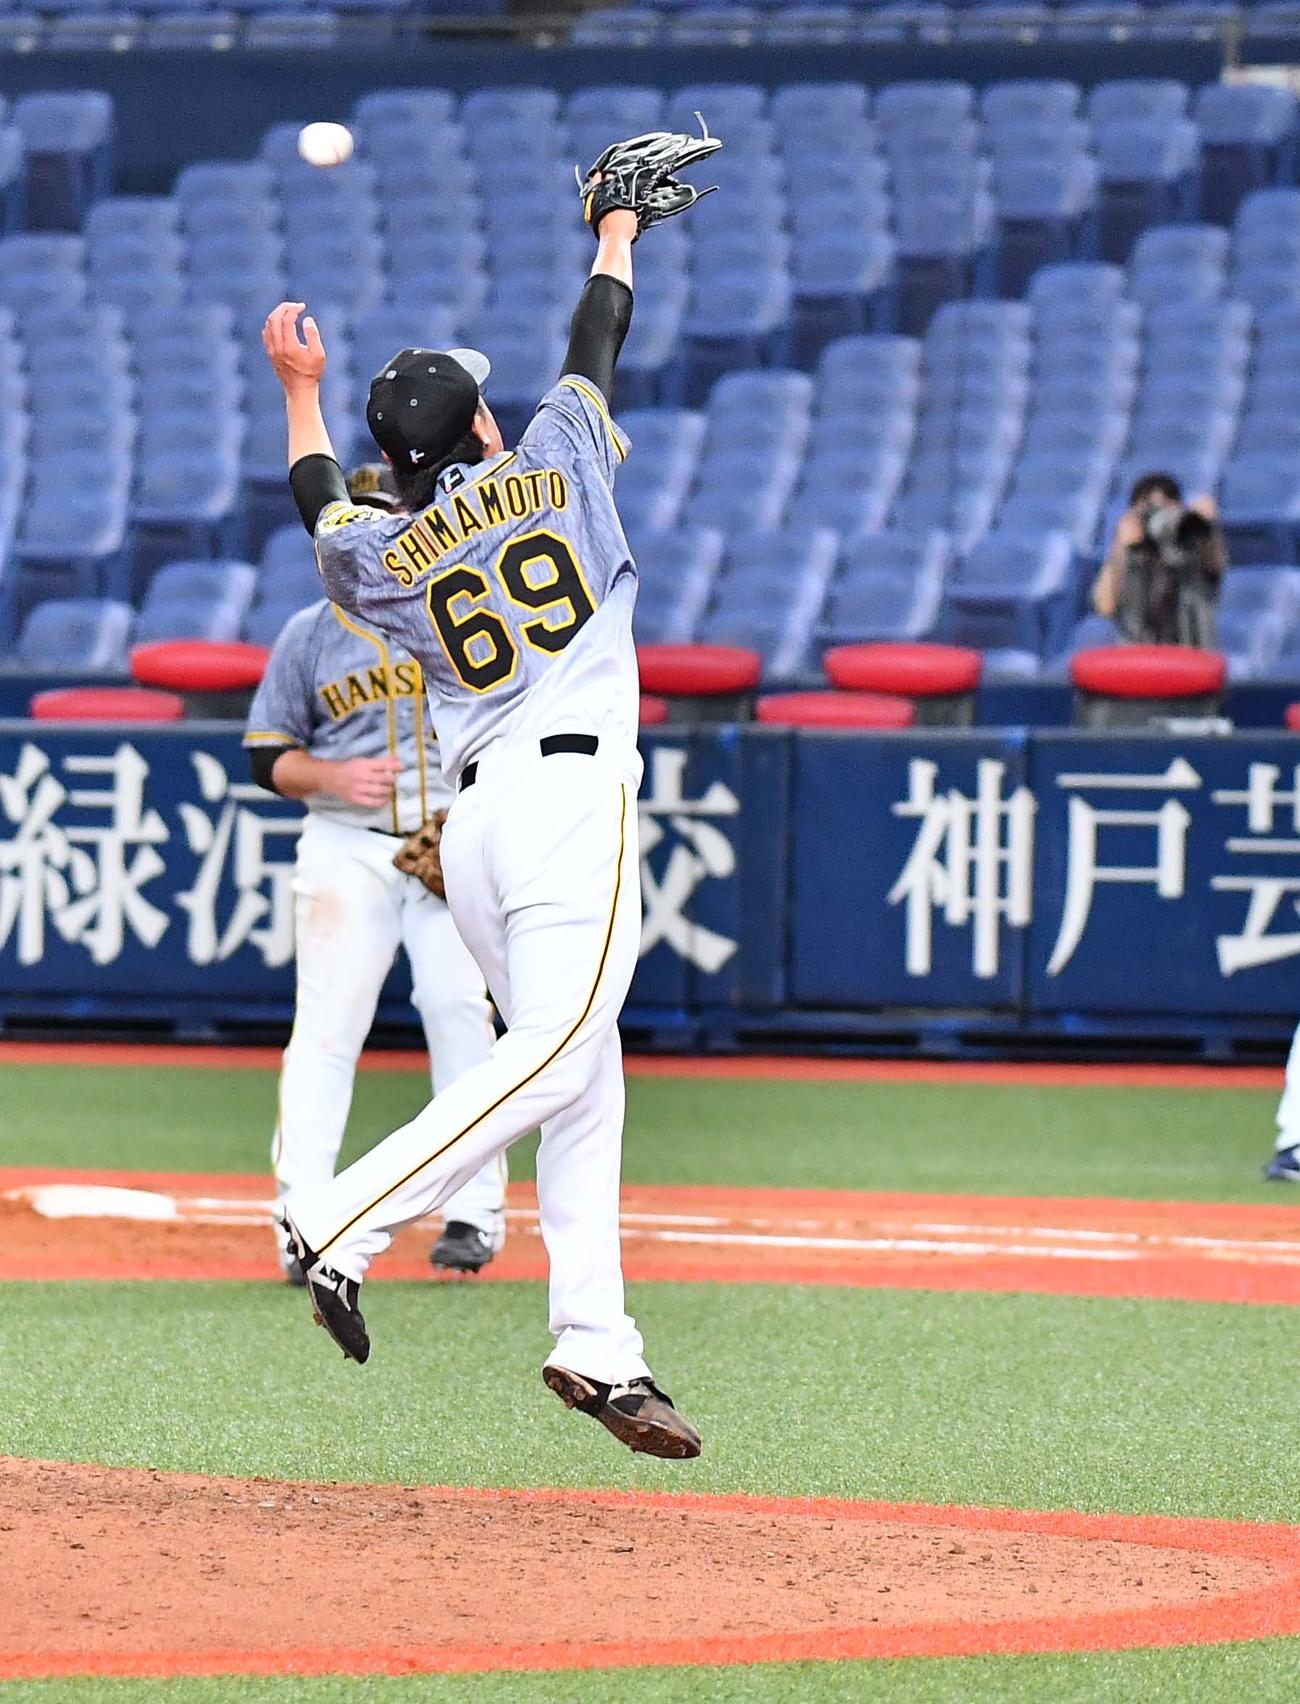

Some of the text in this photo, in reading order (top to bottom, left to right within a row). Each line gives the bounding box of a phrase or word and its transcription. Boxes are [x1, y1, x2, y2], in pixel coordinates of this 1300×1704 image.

[384, 467, 569, 587] SHIMAMOTO
[426, 528, 597, 694] 69
[319, 660, 428, 719] HANS
